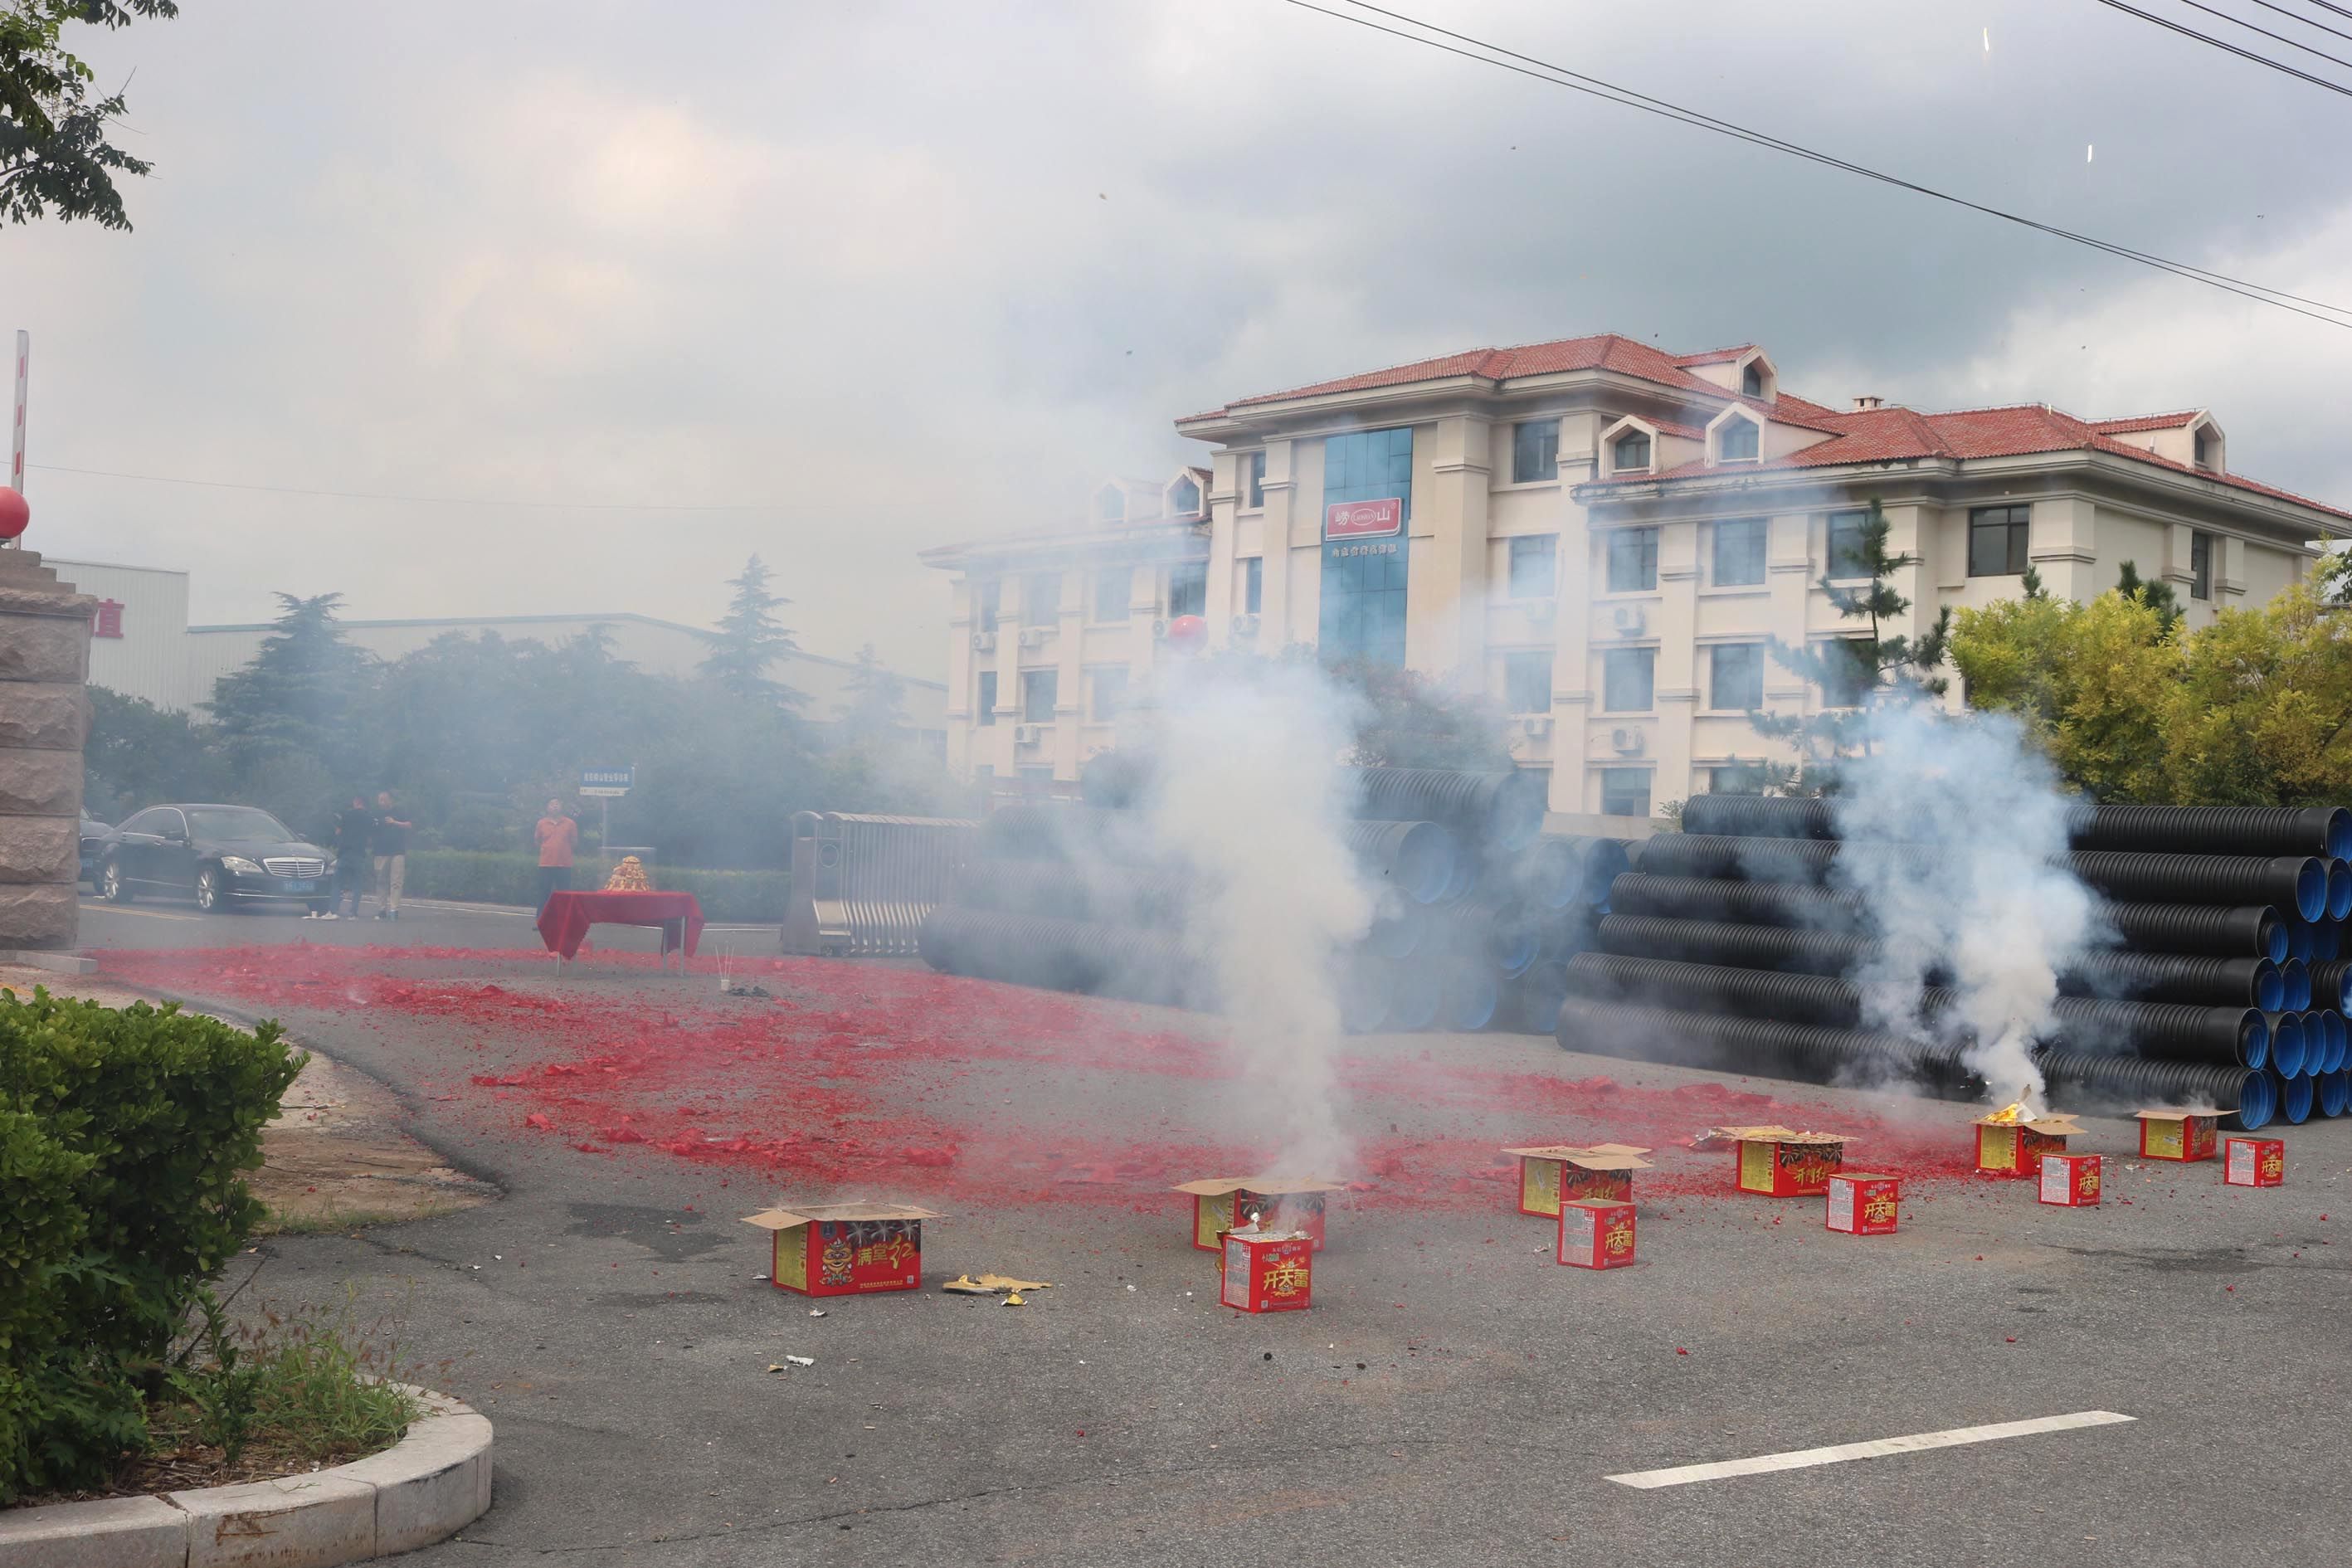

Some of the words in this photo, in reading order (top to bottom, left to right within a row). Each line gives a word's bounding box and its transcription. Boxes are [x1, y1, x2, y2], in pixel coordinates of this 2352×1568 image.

[1376, 508, 1390, 522] 山
[1864, 1201, 1897, 1219] 开天雷
[1605, 1230, 1634, 1250] 开天雷
[857, 1234, 916, 1270] 满堂红
[1264, 1268, 1310, 1291] 开天雷
